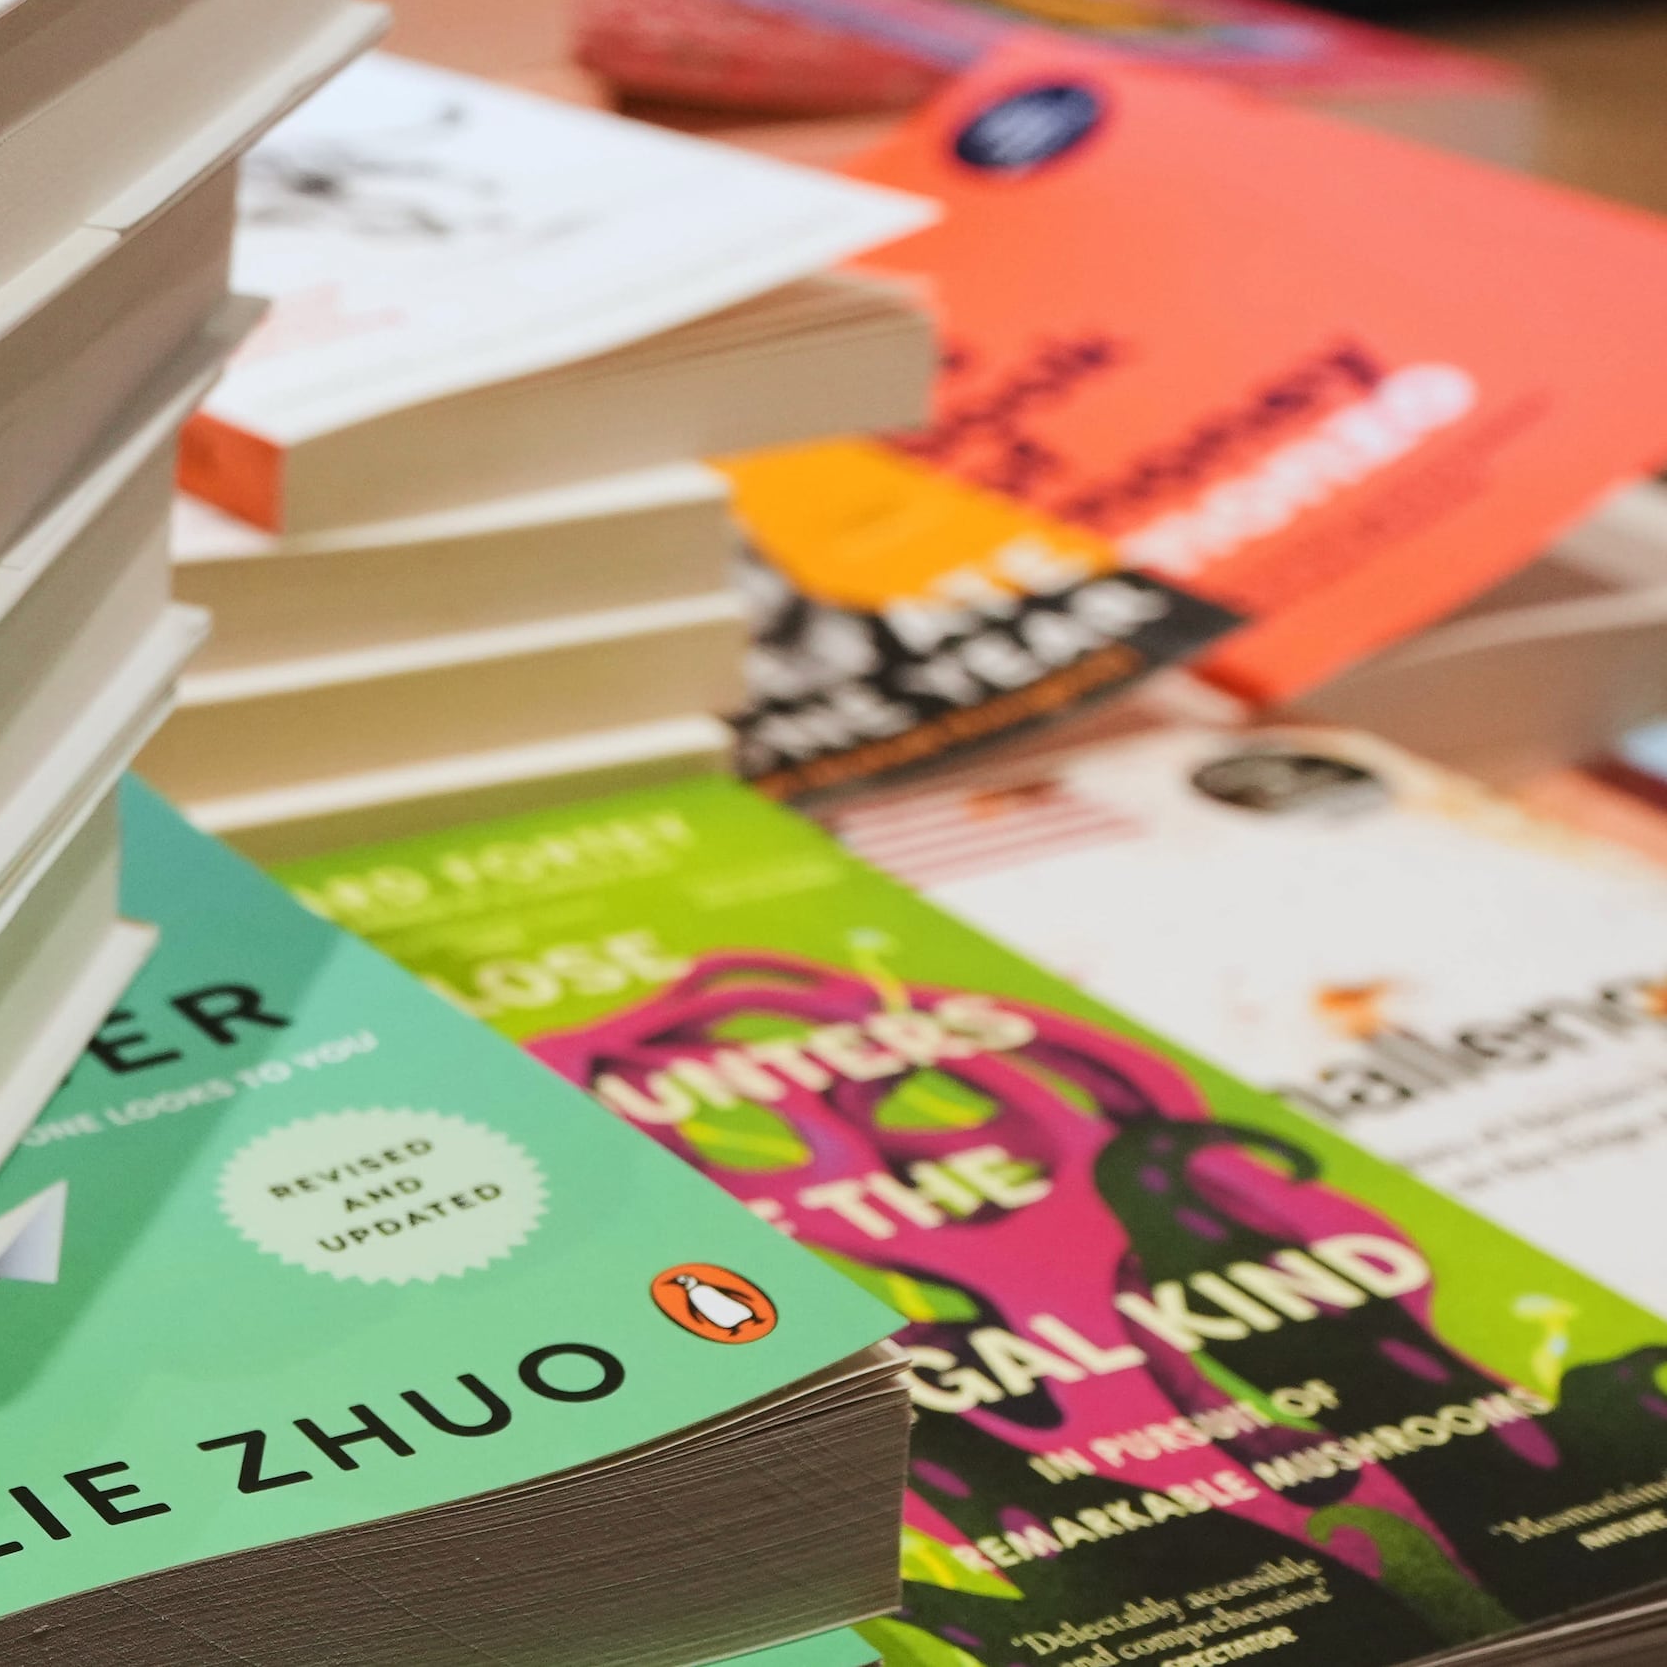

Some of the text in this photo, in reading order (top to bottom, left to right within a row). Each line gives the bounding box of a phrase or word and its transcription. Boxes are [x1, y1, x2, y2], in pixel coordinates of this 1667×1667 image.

[269, 1138, 433, 1202] REVISED
[343, 1176, 423, 1214] AND
[799, 1144, 1053, 1240] THE
[317, 1184, 503, 1254] UPDATED
[1113, 1232, 1431, 1352] KIND
[197, 1342, 627, 1496] ZHUO
